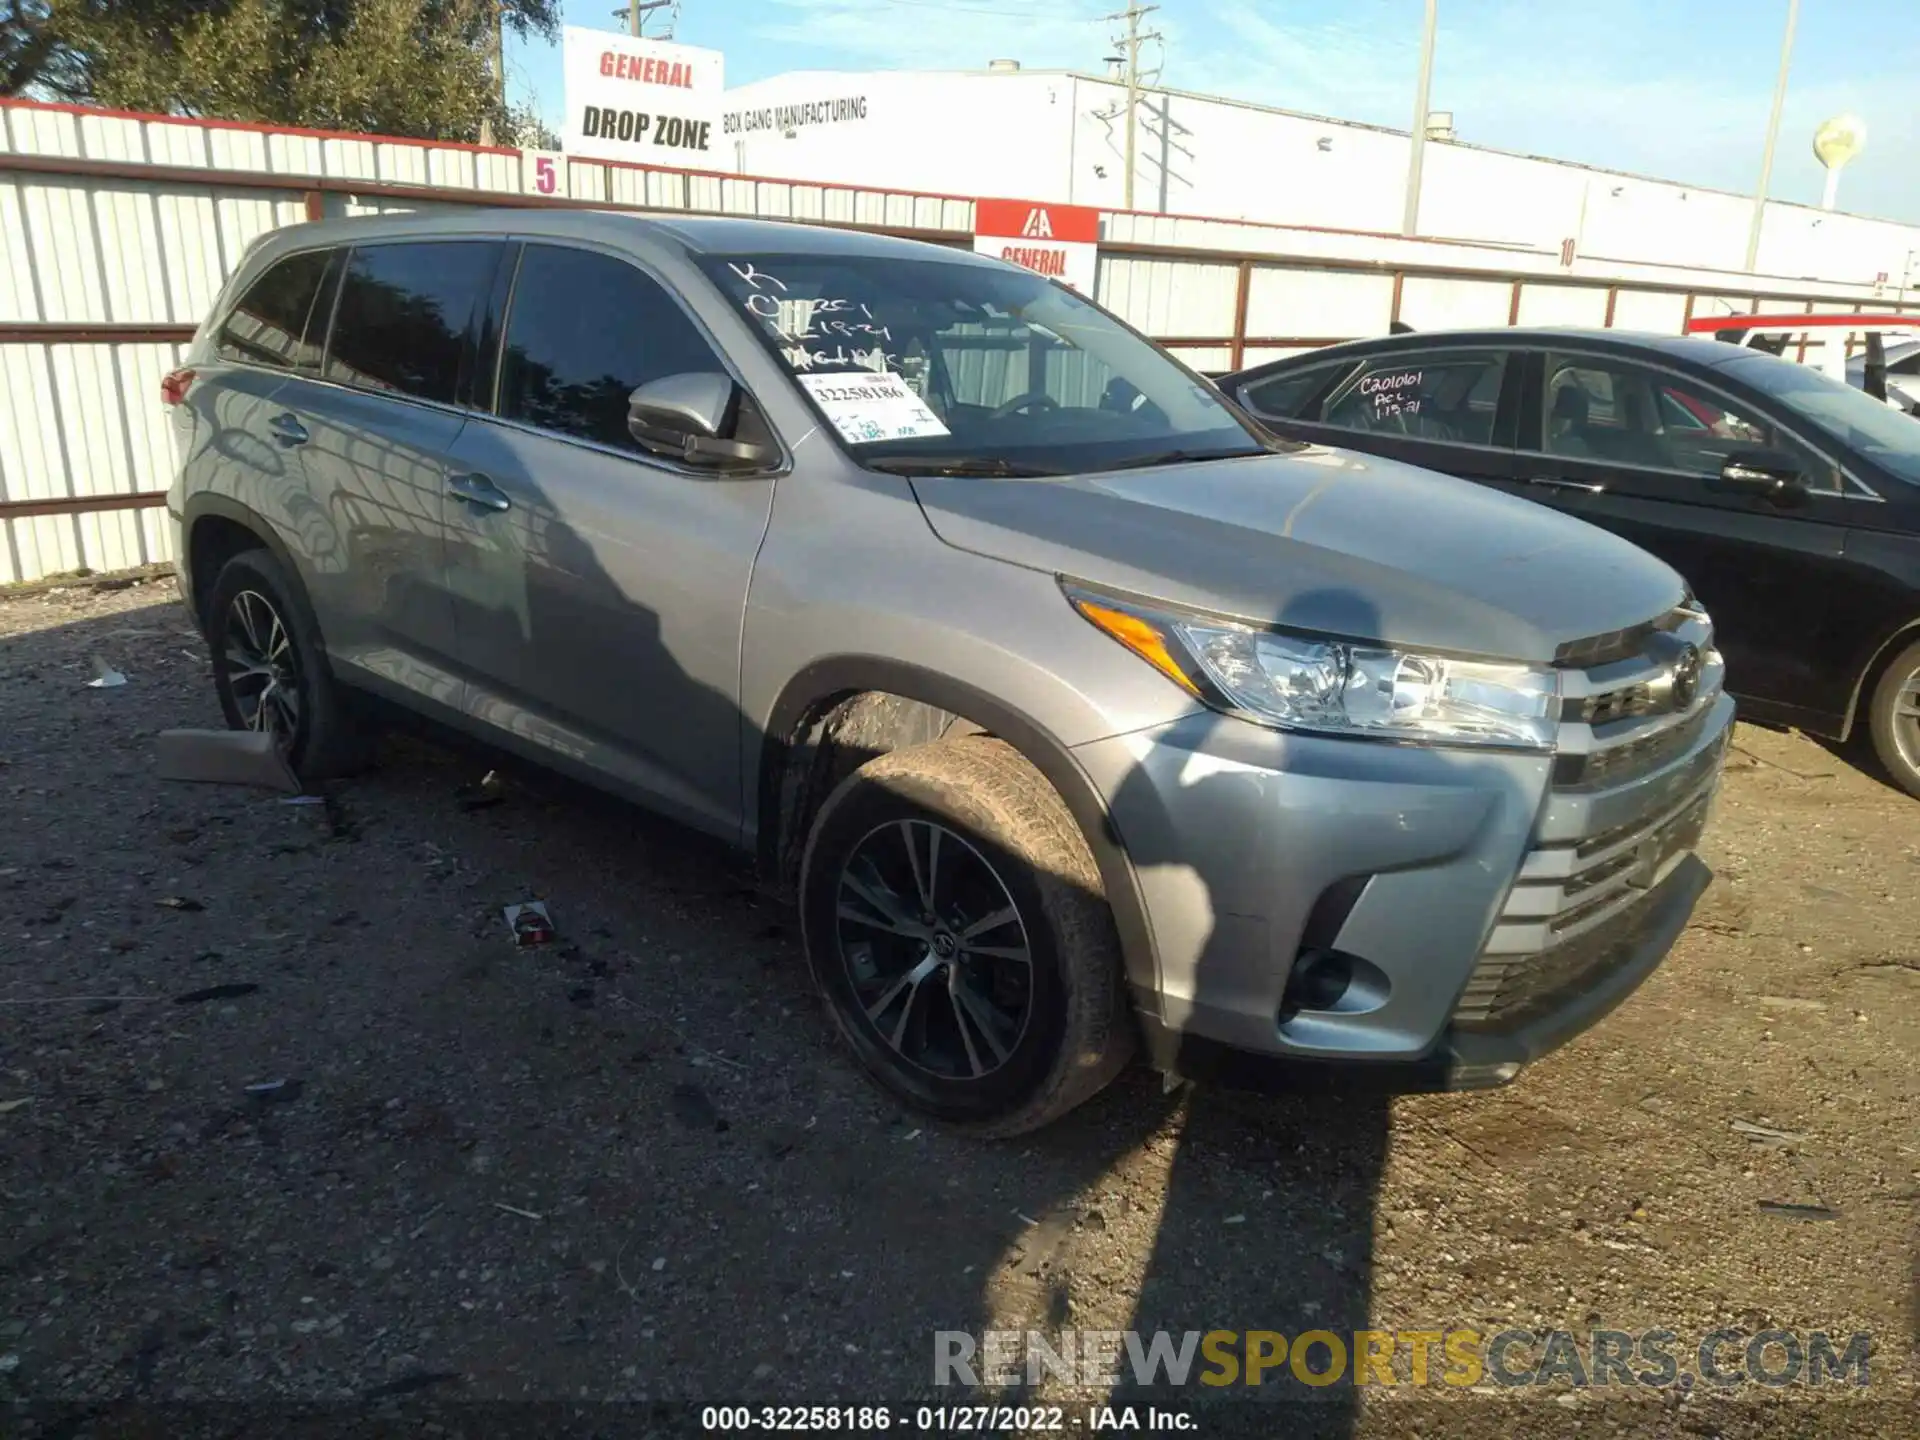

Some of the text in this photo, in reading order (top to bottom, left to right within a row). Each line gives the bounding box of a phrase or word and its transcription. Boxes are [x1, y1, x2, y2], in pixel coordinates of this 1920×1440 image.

[600, 51, 692, 88] GENERAL
[583, 105, 711, 150] DROP ZONE
[723, 95, 867, 134] BOX GANG MANUFACTURING
[536, 157, 555, 194] 5
[1560, 238, 1575, 267] 10
[815, 386, 904, 402] 32258186
